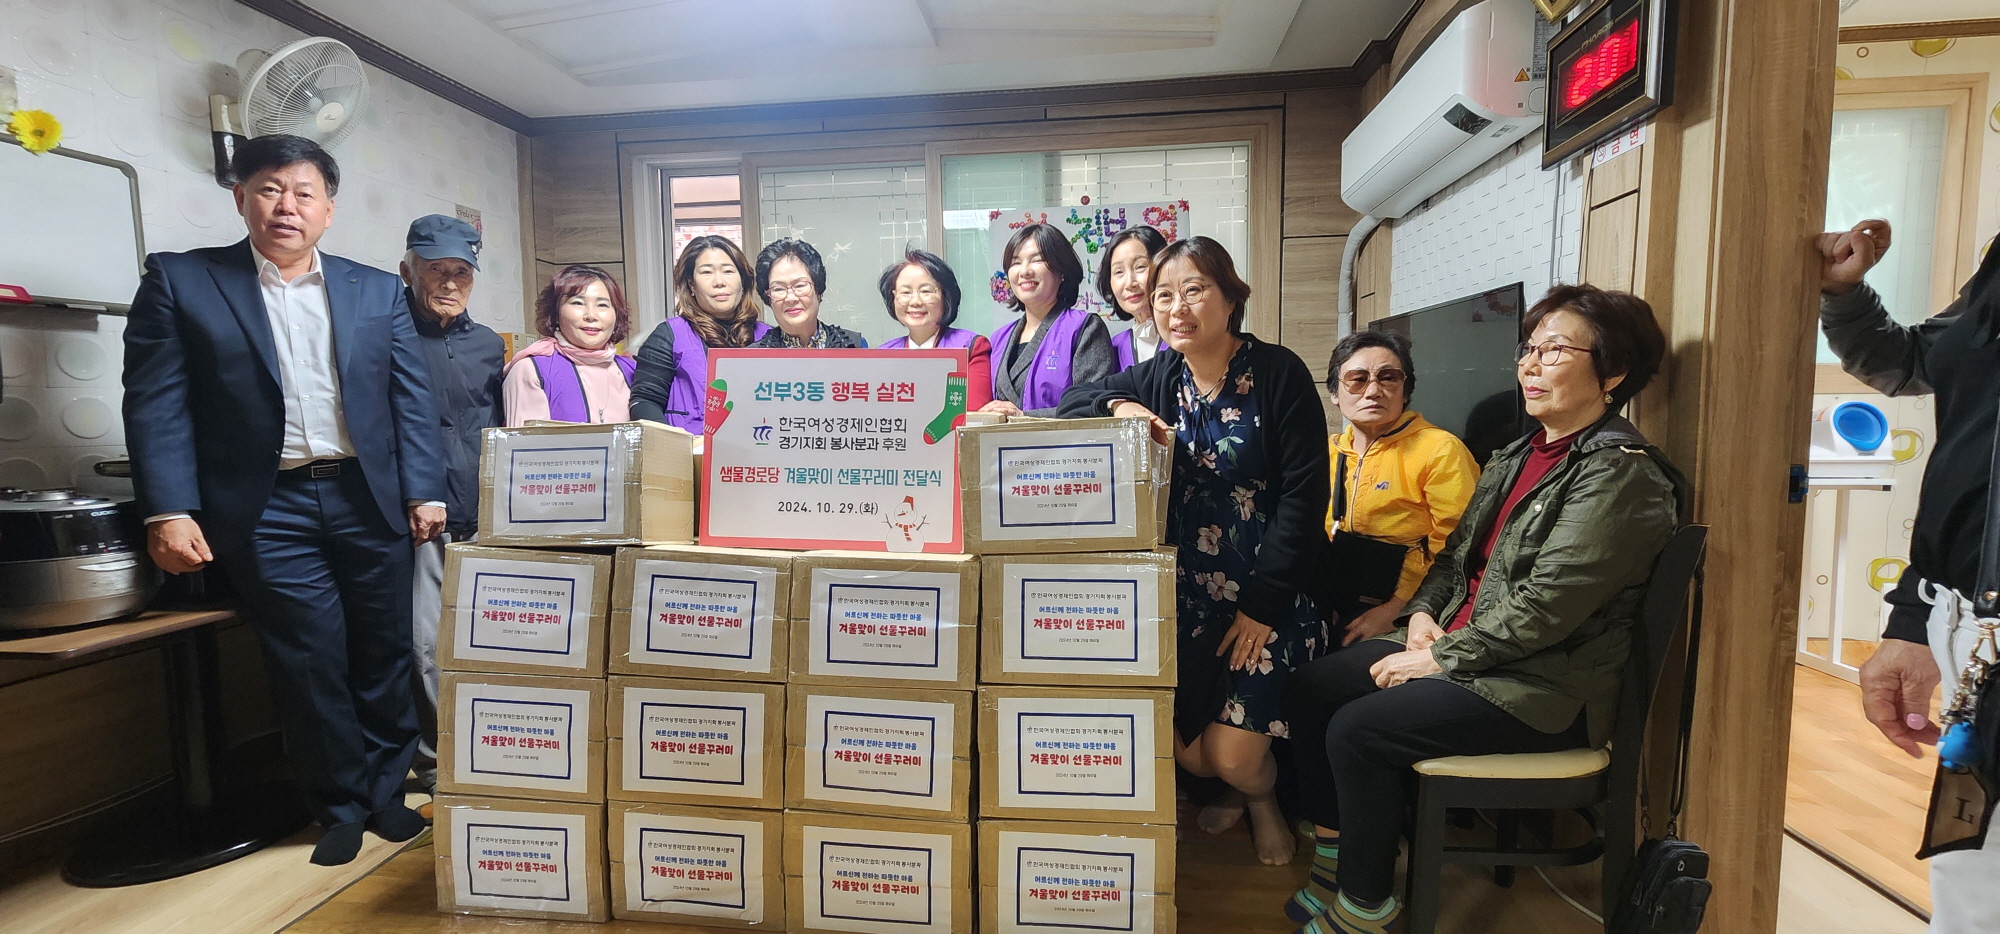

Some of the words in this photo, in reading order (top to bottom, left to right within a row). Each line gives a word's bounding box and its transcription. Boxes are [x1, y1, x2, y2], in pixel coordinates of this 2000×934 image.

[754, 381, 825, 402] 선부3동
[831, 382, 870, 402] 행복
[876, 382, 915, 402] 실천
[778, 417, 907, 433] 한국여성경제인협회
[779, 436, 826, 451] 경기지회
[830, 437, 879, 451] 봉사분과
[882, 437, 907, 451] 후원
[548, 472, 562, 480] 전하는
[581, 472, 591, 480] 마음
[720, 466, 780, 484] 샘물경로당
[784, 467, 833, 485] 겨울맞이
[837, 468, 898, 486] 선물꾸러미
[903, 469, 942, 487] 전달식
[1017, 472, 1041, 480] 어르신께
[1043, 472, 1061, 480] 전하는
[1063, 472, 1082, 480] 따뜻한
[1084, 470, 1096, 478] 마음
[520, 484, 552, 496] 겨울맞이
[555, 482, 595, 494] 선물꾸러미
[1012, 484, 1049, 496] 겨울맞이
[1054, 482, 1101, 496] 선물꾸러미
[778, 502, 811, 513] 2024.
[817, 502, 834, 513] 10.
[840, 502, 879, 515] 29.(화)
[488, 598, 509, 606] 어르신께
[511, 600, 527, 608] 전하는
[529, 602, 545, 610] 따뜻한
[547, 602, 557, 610] 마음
[665, 602, 688, 610] 어르신께
[690, 604, 706, 612] 전하는
[708, 604, 725, 612] 따뜻한
[727, 606, 737, 614] 마음
[1039, 606, 1064, 614] 어르신께
[1066, 606, 1084, 614] 전하는
[1086, 606, 1105, 614] 따뜻한
[1107, 606, 1118, 614] 마음
[482, 610, 515, 622] 겨울맞이
[519, 612, 561, 624] 선물꾸러미
[660, 612, 694, 626] 겨울맞이
[698, 616, 742, 628] 선물꾸러미
[845, 610, 868, 618] 어르신께
[890, 612, 908, 620] 따뜻한
[910, 614, 921, 622] 마음
[839, 622, 875, 636] 겨울맞이
[879, 624, 926, 638] 선물꾸러미
[1034, 618, 1072, 630] 겨울맞이
[1076, 618, 1124, 630] 선물꾸러미
[510, 726, 525, 734] 전하는
[527, 728, 542, 736] 따뜻한
[544, 728, 554, 736] 마음
[656, 730, 678, 738] 어르신께
[680, 730, 696, 738] 전하는
[699, 732, 715, 740] 따뜻한
[717, 732, 728, 740] 마음
[482, 736, 515, 748] 겨울맞이
[519, 738, 559, 750] 선물꾸러미
[651, 740, 685, 754] 겨울맞이
[689, 742, 733, 756] 선물꾸러미
[841, 738, 864, 746] 어르신께
[866, 740, 883, 748] 전하는
[885, 742, 903, 750] 따뜻한
[905, 742, 916, 750] 마음
[1036, 740, 1060, 748] 어르신께
[1063, 742, 1080, 750] 전하는
[1083, 742, 1102, 750] 따뜻한
[1104, 742, 1116, 750] 마음
[835, 750, 870, 762] 겨울맞이
[874, 752, 921, 766] 선물꾸러미
[1030, 752, 1069, 766] 겨울맞이
[1073, 754, 1121, 766] 선물꾸러미
[1952, 797, 1975, 825] L
[482, 850, 504, 858] 어르신께
[506, 850, 521, 858] 전하는
[523, 852, 539, 860] 따뜻한
[541, 852, 551, 860] 마음
[655, 856, 677, 864] 어르신께
[679, 858, 695, 866] 전하는
[697, 858, 714, 866] 따뜻한
[716, 860, 726, 868] 마음
[478, 860, 512, 872] 겨울맞이
[515, 862, 557, 874] 선물꾸러미
[651, 866, 684, 878] 겨울맞이
[688, 870, 732, 882] 선물꾸러미
[837, 870, 860, 878] 어르신께
[862, 872, 879, 880] 전하는
[881, 874, 899, 882] 따뜻한
[901, 874, 913, 882] 마음
[1035, 876, 1060, 884] 어르신께
[1062, 878, 1080, 886] 전하는
[1082, 878, 1101, 888] 따뜻한
[1103, 880, 1115, 890] 마음
[832, 880, 868, 892] 겨울맞이
[872, 882, 919, 896] 선물꾸러미
[1029, 888, 1068, 900] 겨울맞이
[1072, 890, 1120, 902] 선물꾸러미
